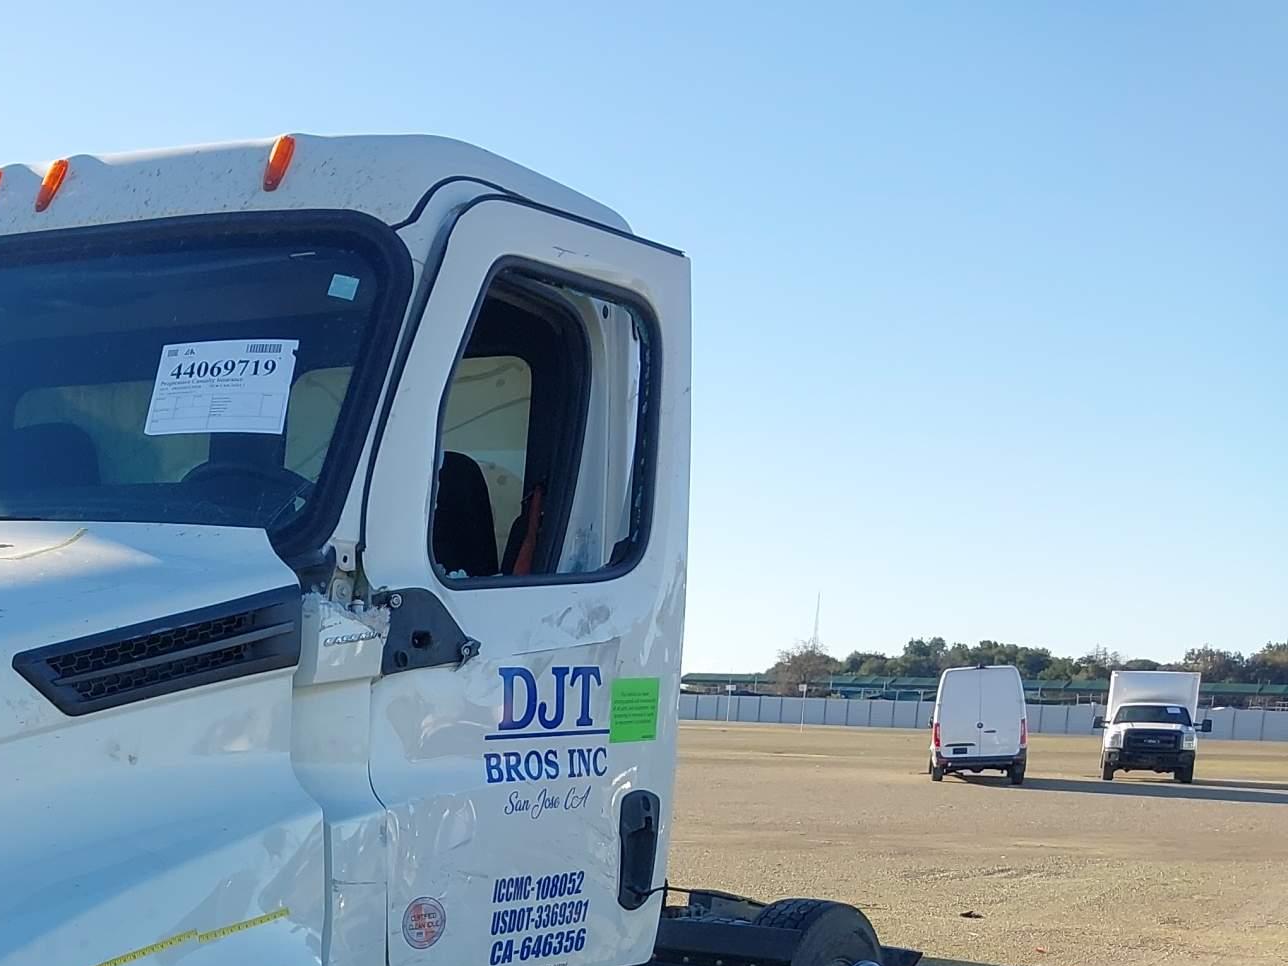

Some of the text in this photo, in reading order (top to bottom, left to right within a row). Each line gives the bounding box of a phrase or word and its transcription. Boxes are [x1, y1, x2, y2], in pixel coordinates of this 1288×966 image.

[170, 359, 277, 379] 44069719
[498, 666, 602, 731] DJT
[484, 747, 607, 783] BROS INC
[504, 785, 591, 819] San Jose CA
[492, 870, 585, 903] ICCMC-108052
[491, 899, 590, 936] USDOT-3369391
[490, 928, 587, 966] CA-646356
